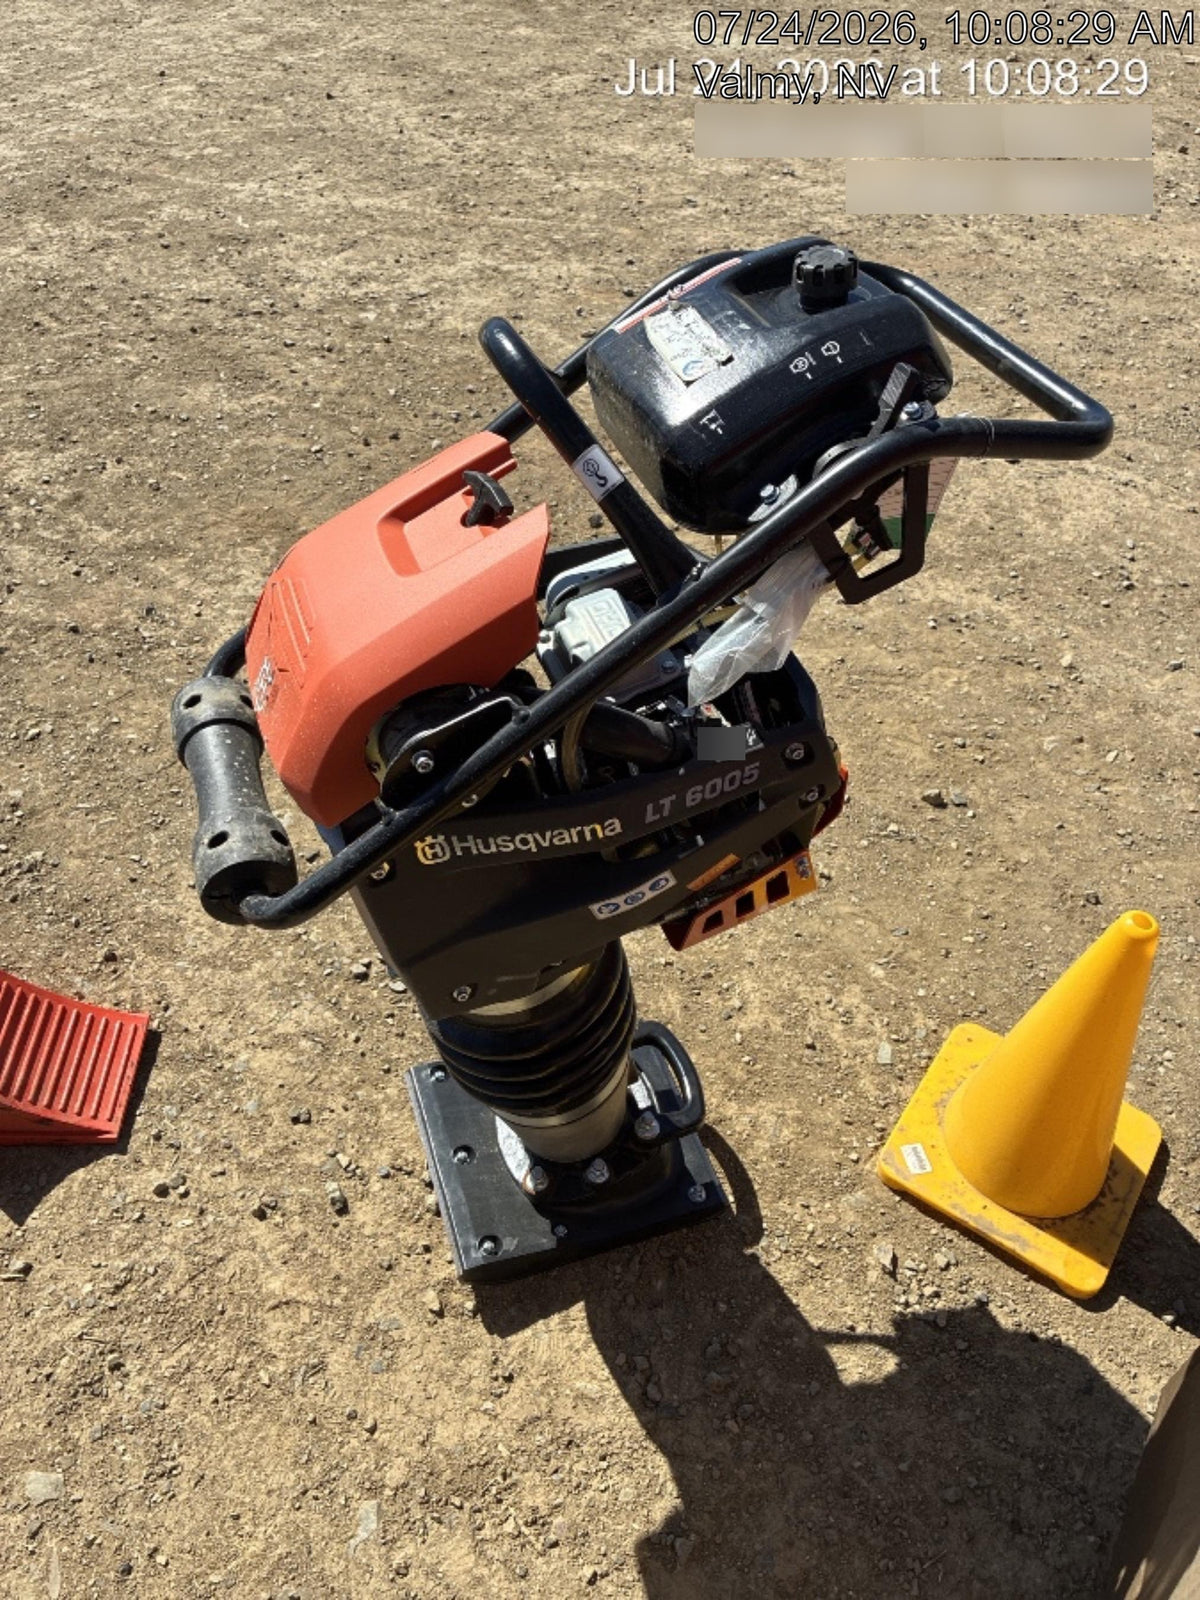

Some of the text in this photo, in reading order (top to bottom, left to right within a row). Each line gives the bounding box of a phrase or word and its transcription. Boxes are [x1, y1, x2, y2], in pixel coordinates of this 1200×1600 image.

[645, 761, 761, 824] LT 6005
[453, 817, 623, 857] Husqvarna
